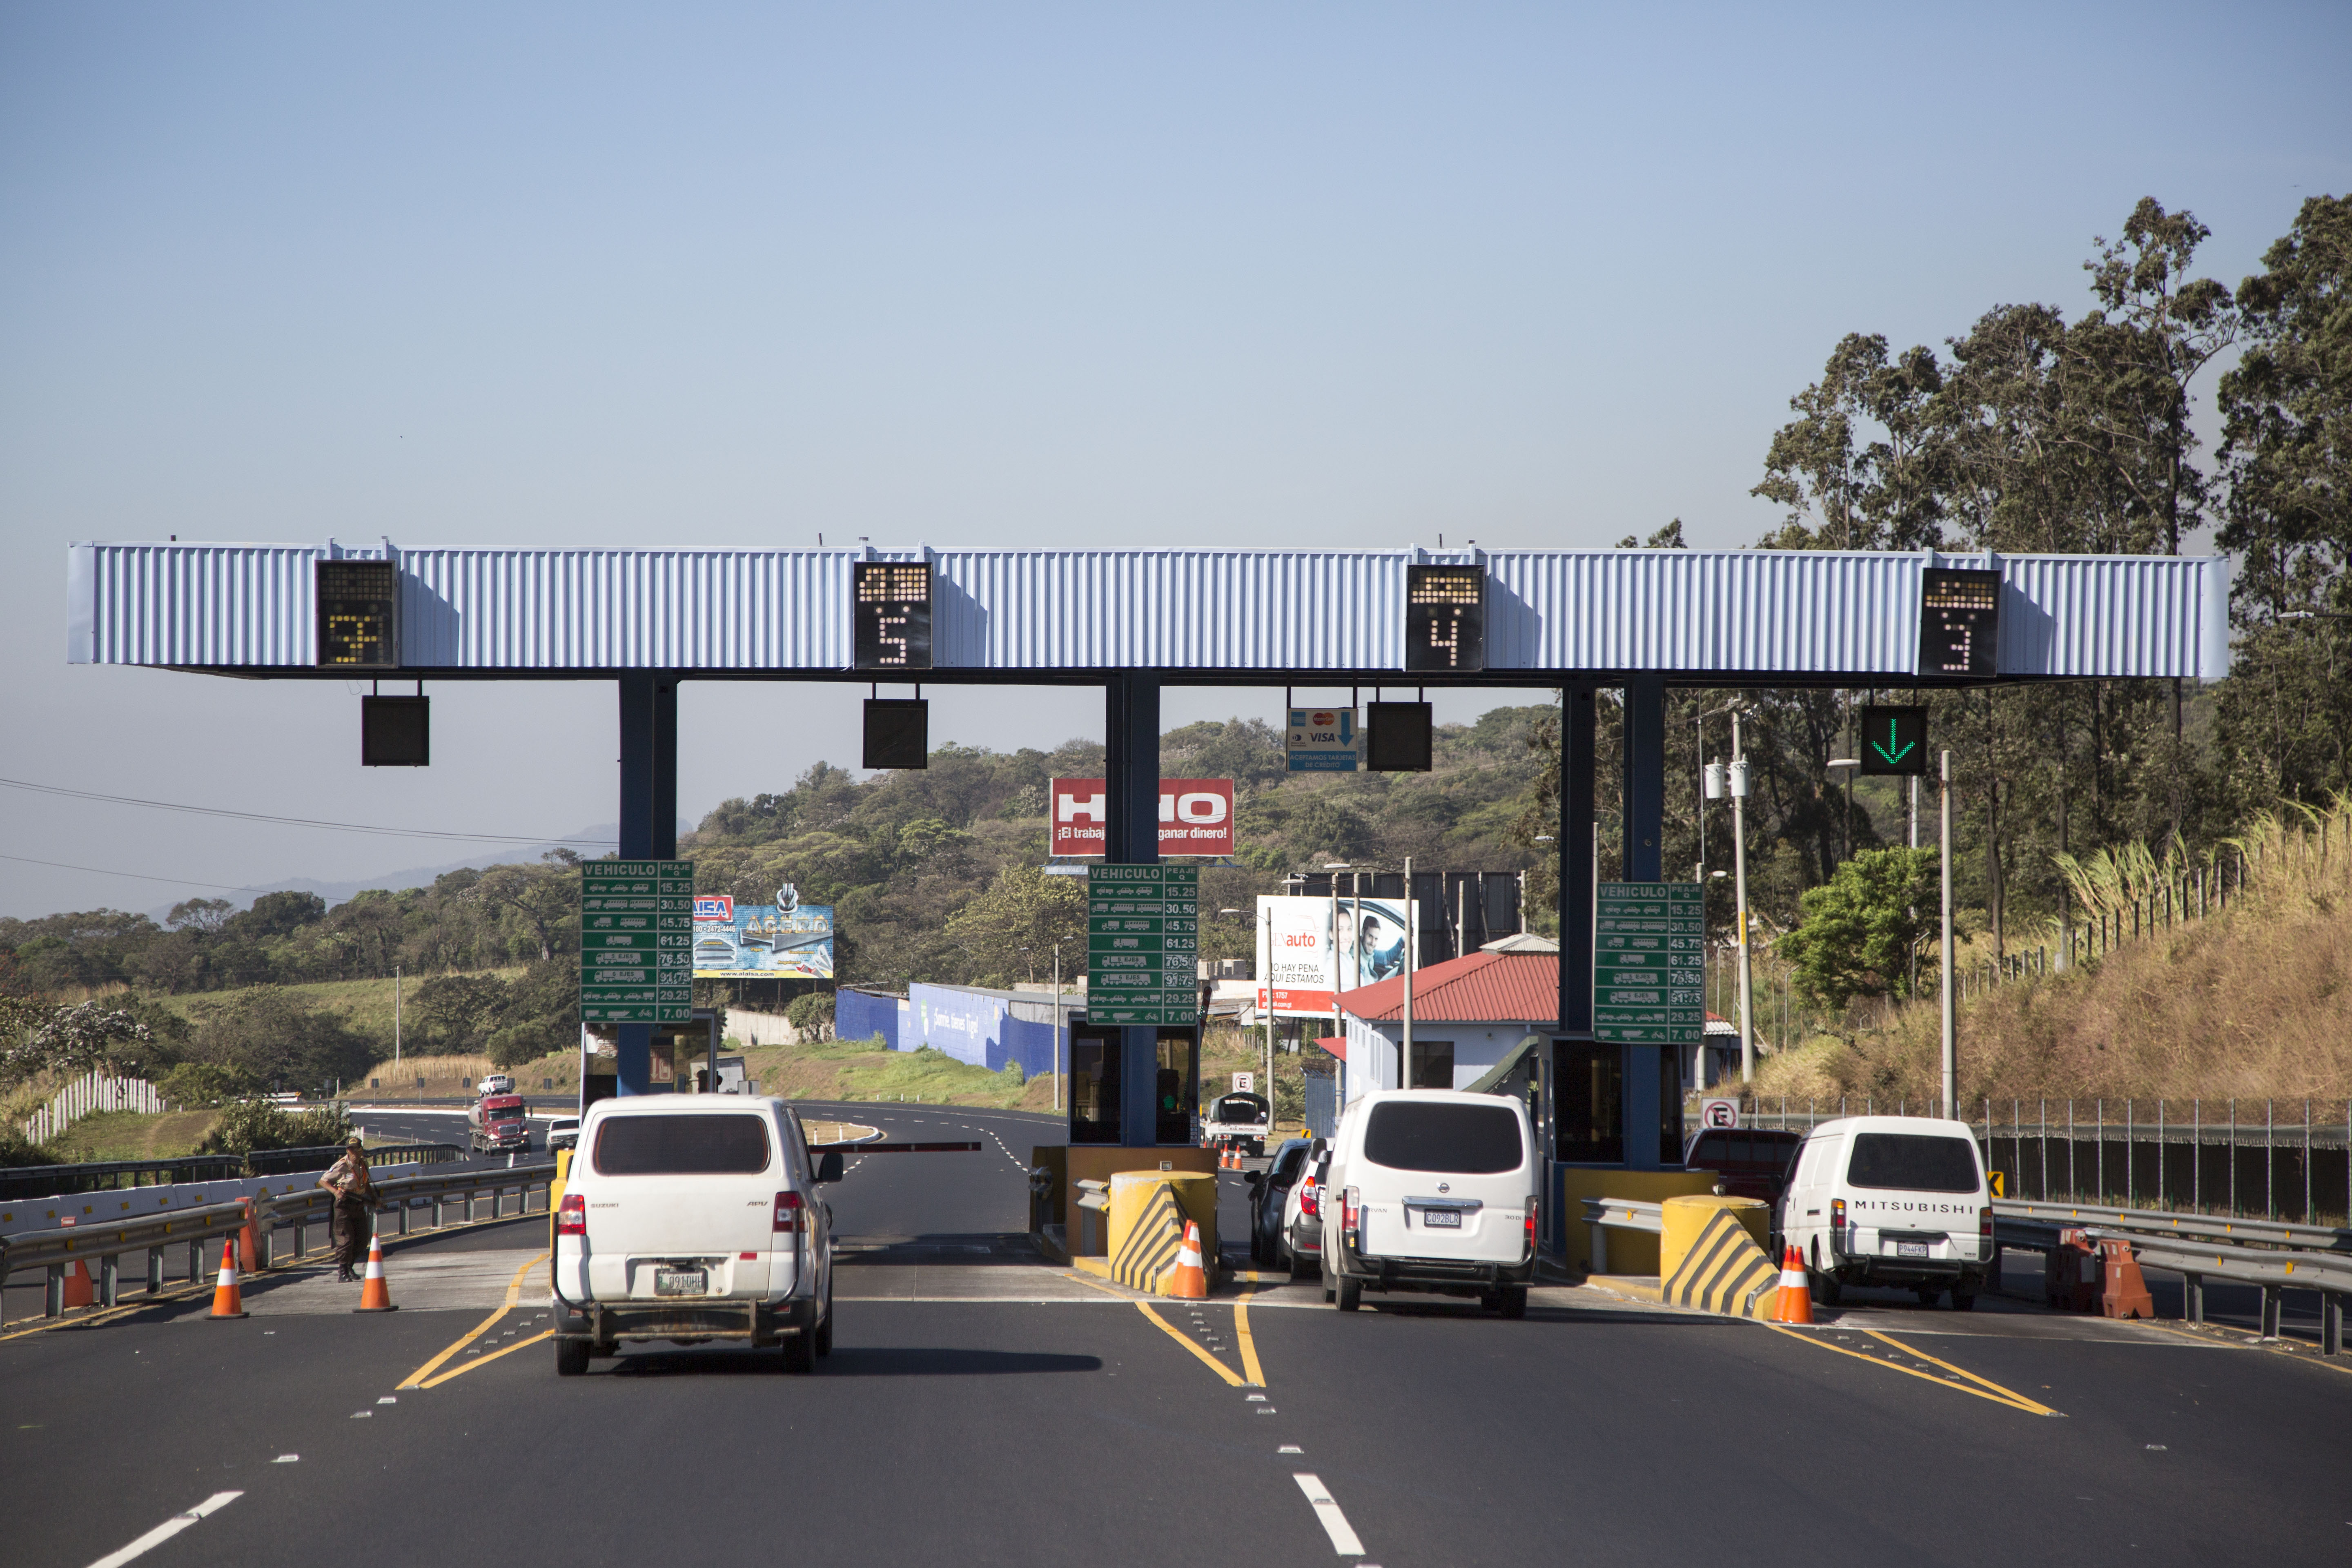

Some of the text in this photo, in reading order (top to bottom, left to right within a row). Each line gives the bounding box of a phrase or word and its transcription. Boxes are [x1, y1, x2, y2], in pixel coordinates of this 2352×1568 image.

[879, 617, 906, 664] 5
[1430, 620, 1458, 666] 4
[1308, 733, 1335, 742] VISA
[1058, 793, 1227, 824] HO
[1058, 827, 1227, 841] ¡El trabaj ganar dinero!
[585, 864, 655, 876] VEHICULO
[1091, 868, 1160, 879] VEHICULO
[661, 883, 691, 893] 15.25
[1167, 887, 1196, 897] 15.25
[1599, 886, 1666, 897] VEHICULO
[661, 900, 690, 910] 30.50
[1166, 904, 1196, 914] 30.50
[1671, 905, 1702, 915] 15.25
[660, 918, 690, 928] 45.75
[746, 918, 828, 933] ACERO
[1166, 921, 1196, 931] 45.75
[1671, 922, 1702, 932] 30.50
[660, 936, 690, 946] 61.25
[1166, 938, 1195, 949] 61.25
[1671, 939, 1702, 949] 45.75
[660, 954, 690, 964] 76.50
[1671, 956, 1702, 965] 61.25
[1286, 974, 1324, 983] ESTAMOS
[1671, 973, 1701, 984] 76.50
[660, 990, 689, 1000] 29.25
[1166, 993, 1194, 1003] 29.25
[664, 1009, 690, 1018] 7.00
[1168, 1011, 1194, 1021] 7.00
[1671, 1012, 1701, 1022] 29.25
[951, 1013, 965, 1031] tienes
[966, 1013, 978, 1039] Tigo!
[1672, 1029, 1700, 1040] 7.00
[1855, 1201, 1973, 1214] MITSUBISHI
